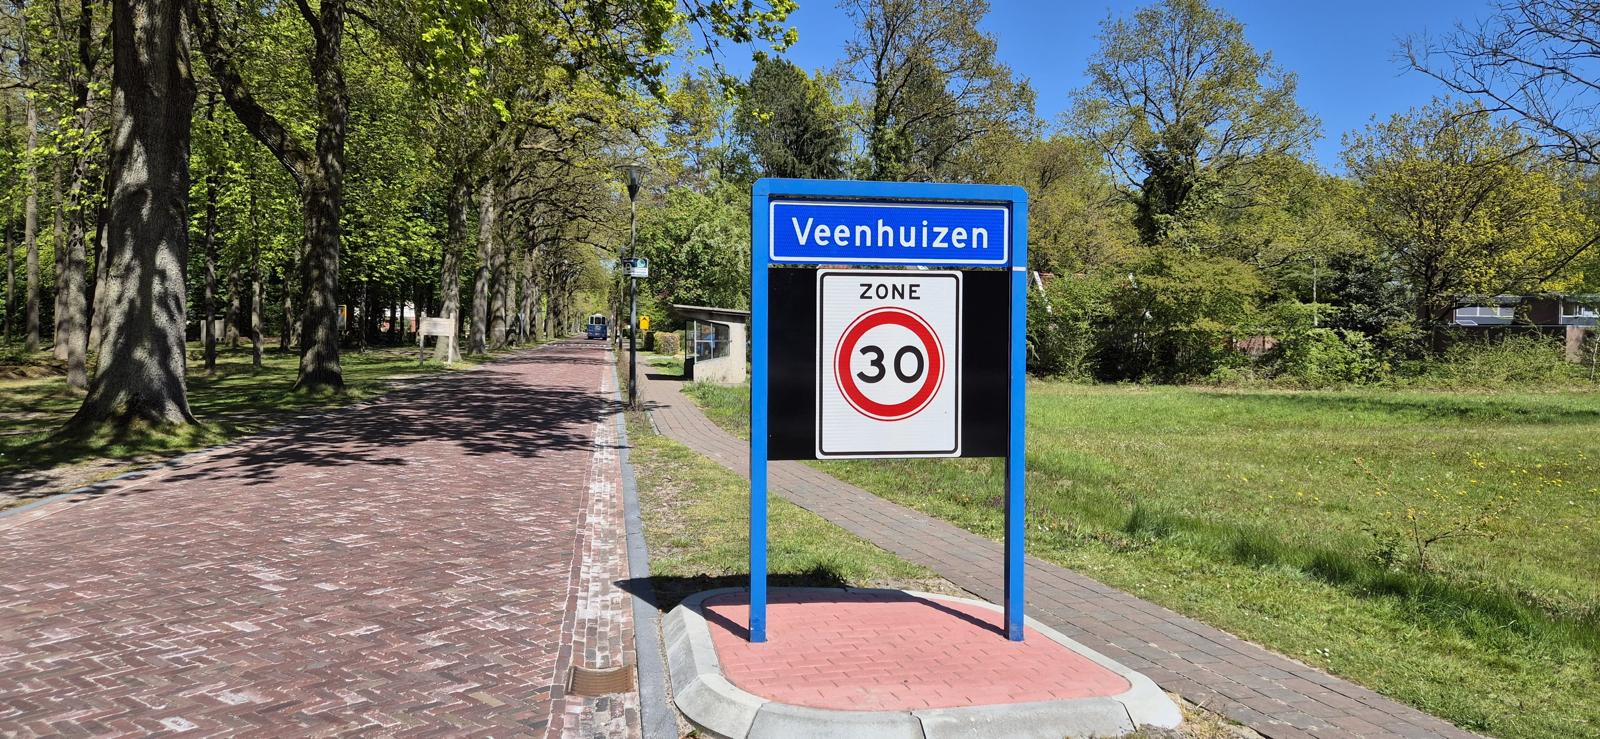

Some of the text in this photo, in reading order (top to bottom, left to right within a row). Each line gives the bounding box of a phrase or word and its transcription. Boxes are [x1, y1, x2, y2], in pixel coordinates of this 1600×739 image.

[792, 217, 988, 249] Veenhuizen
[859, 283, 921, 300] ZONE
[856, 345, 924, 384] 30
